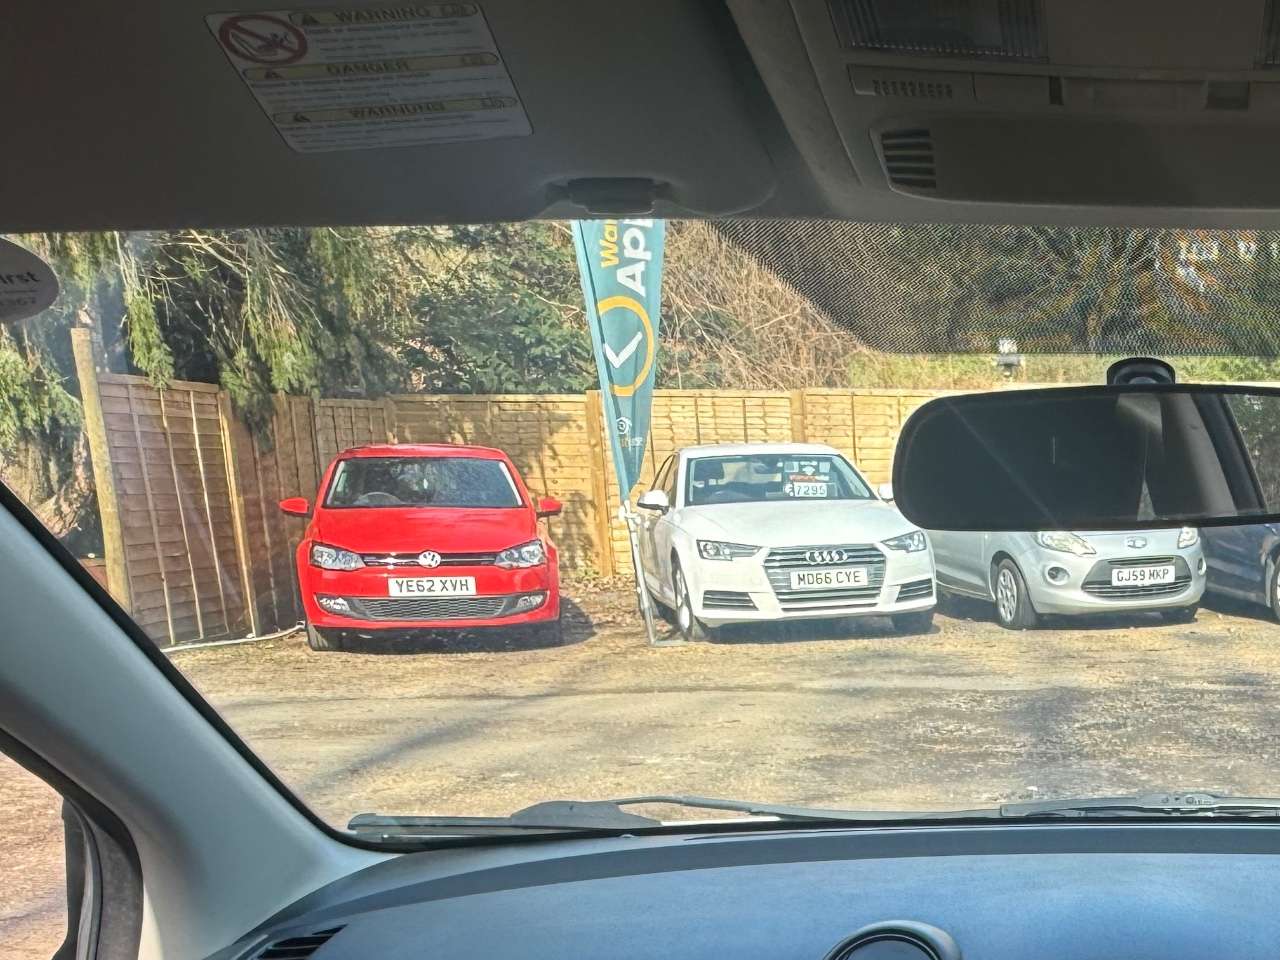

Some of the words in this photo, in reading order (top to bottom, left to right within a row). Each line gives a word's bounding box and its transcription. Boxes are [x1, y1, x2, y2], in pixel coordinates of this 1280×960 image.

[334, 6, 430, 24] WARNING
[325, 58, 410, 75] DANGER
[797, 572, 832, 586] MD66
[835, 570, 861, 584] CYE
[1116, 569, 1146, 582] GJ59
[395, 579, 436, 594] YE62
[439, 578, 470, 592] XVH
